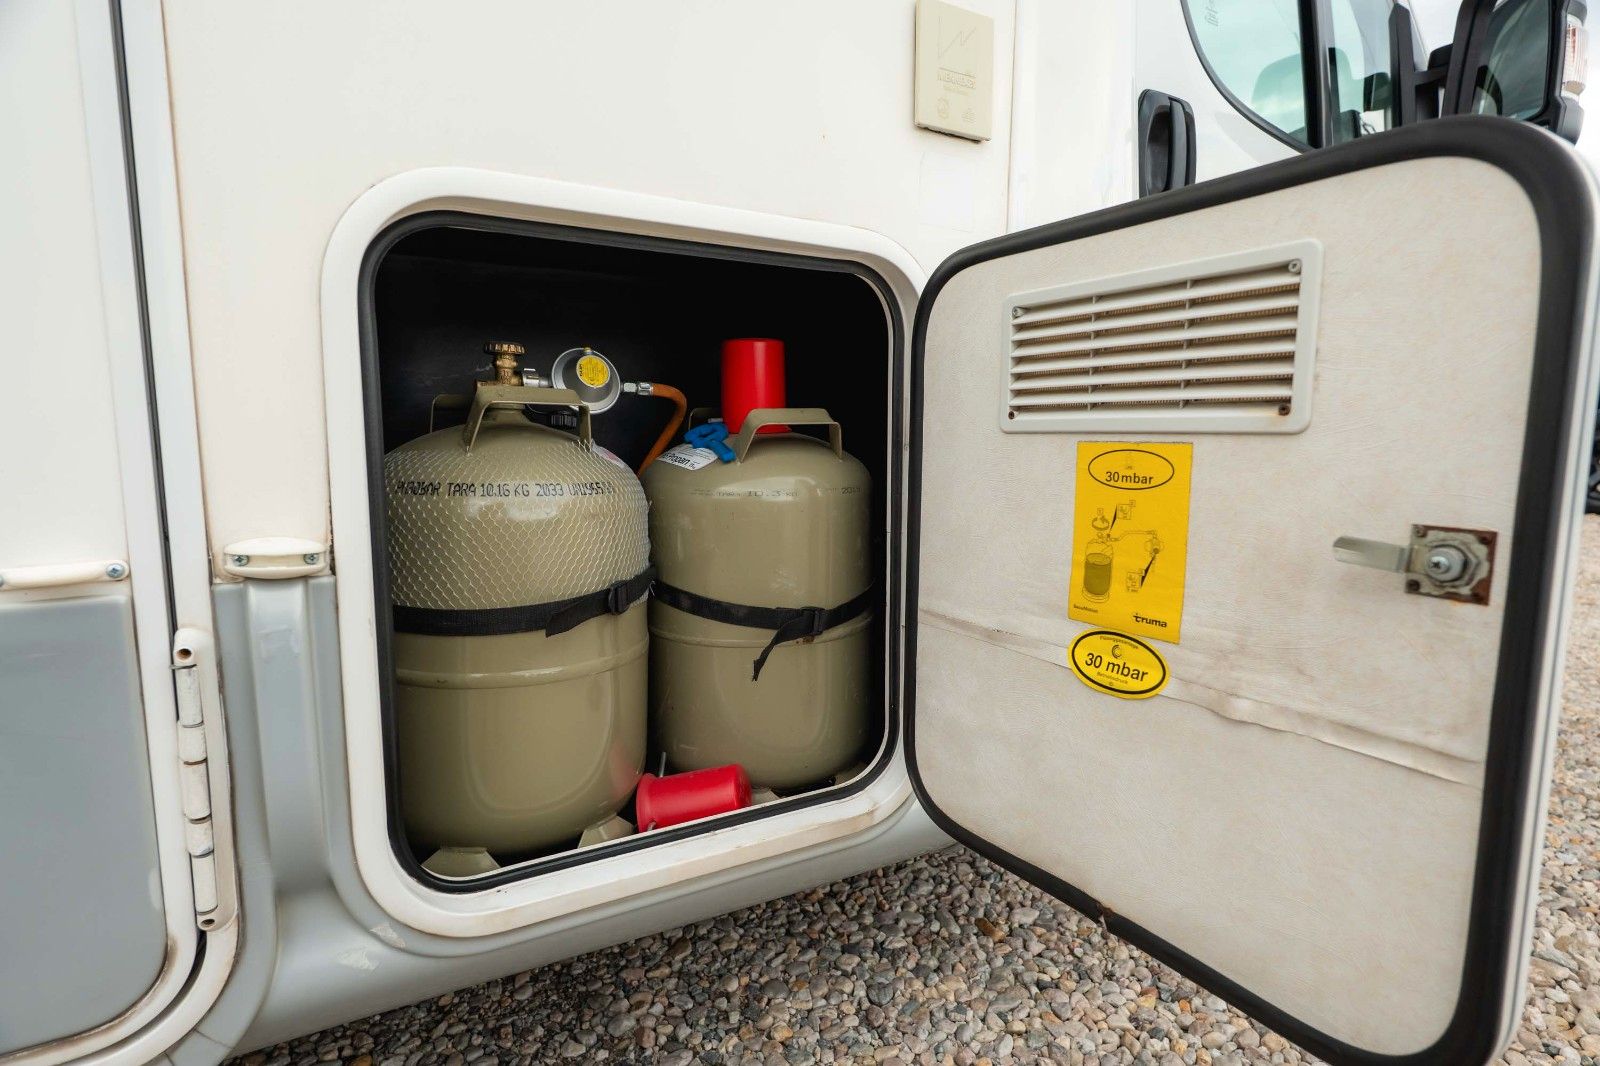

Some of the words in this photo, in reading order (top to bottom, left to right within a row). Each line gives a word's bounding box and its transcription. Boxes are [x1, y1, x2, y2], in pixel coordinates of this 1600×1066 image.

[1105, 471, 1121, 484] 30
[1121, 472, 1154, 485] mbar
[446, 482, 477, 497] TARA
[480, 482, 510, 498] 10.16
[513, 482, 529, 498] KG
[535, 481, 564, 498] 2033
[1132, 612, 1168, 628] truma
[1085, 652, 1103, 669] 30
[1105, 661, 1149, 682] mbar
